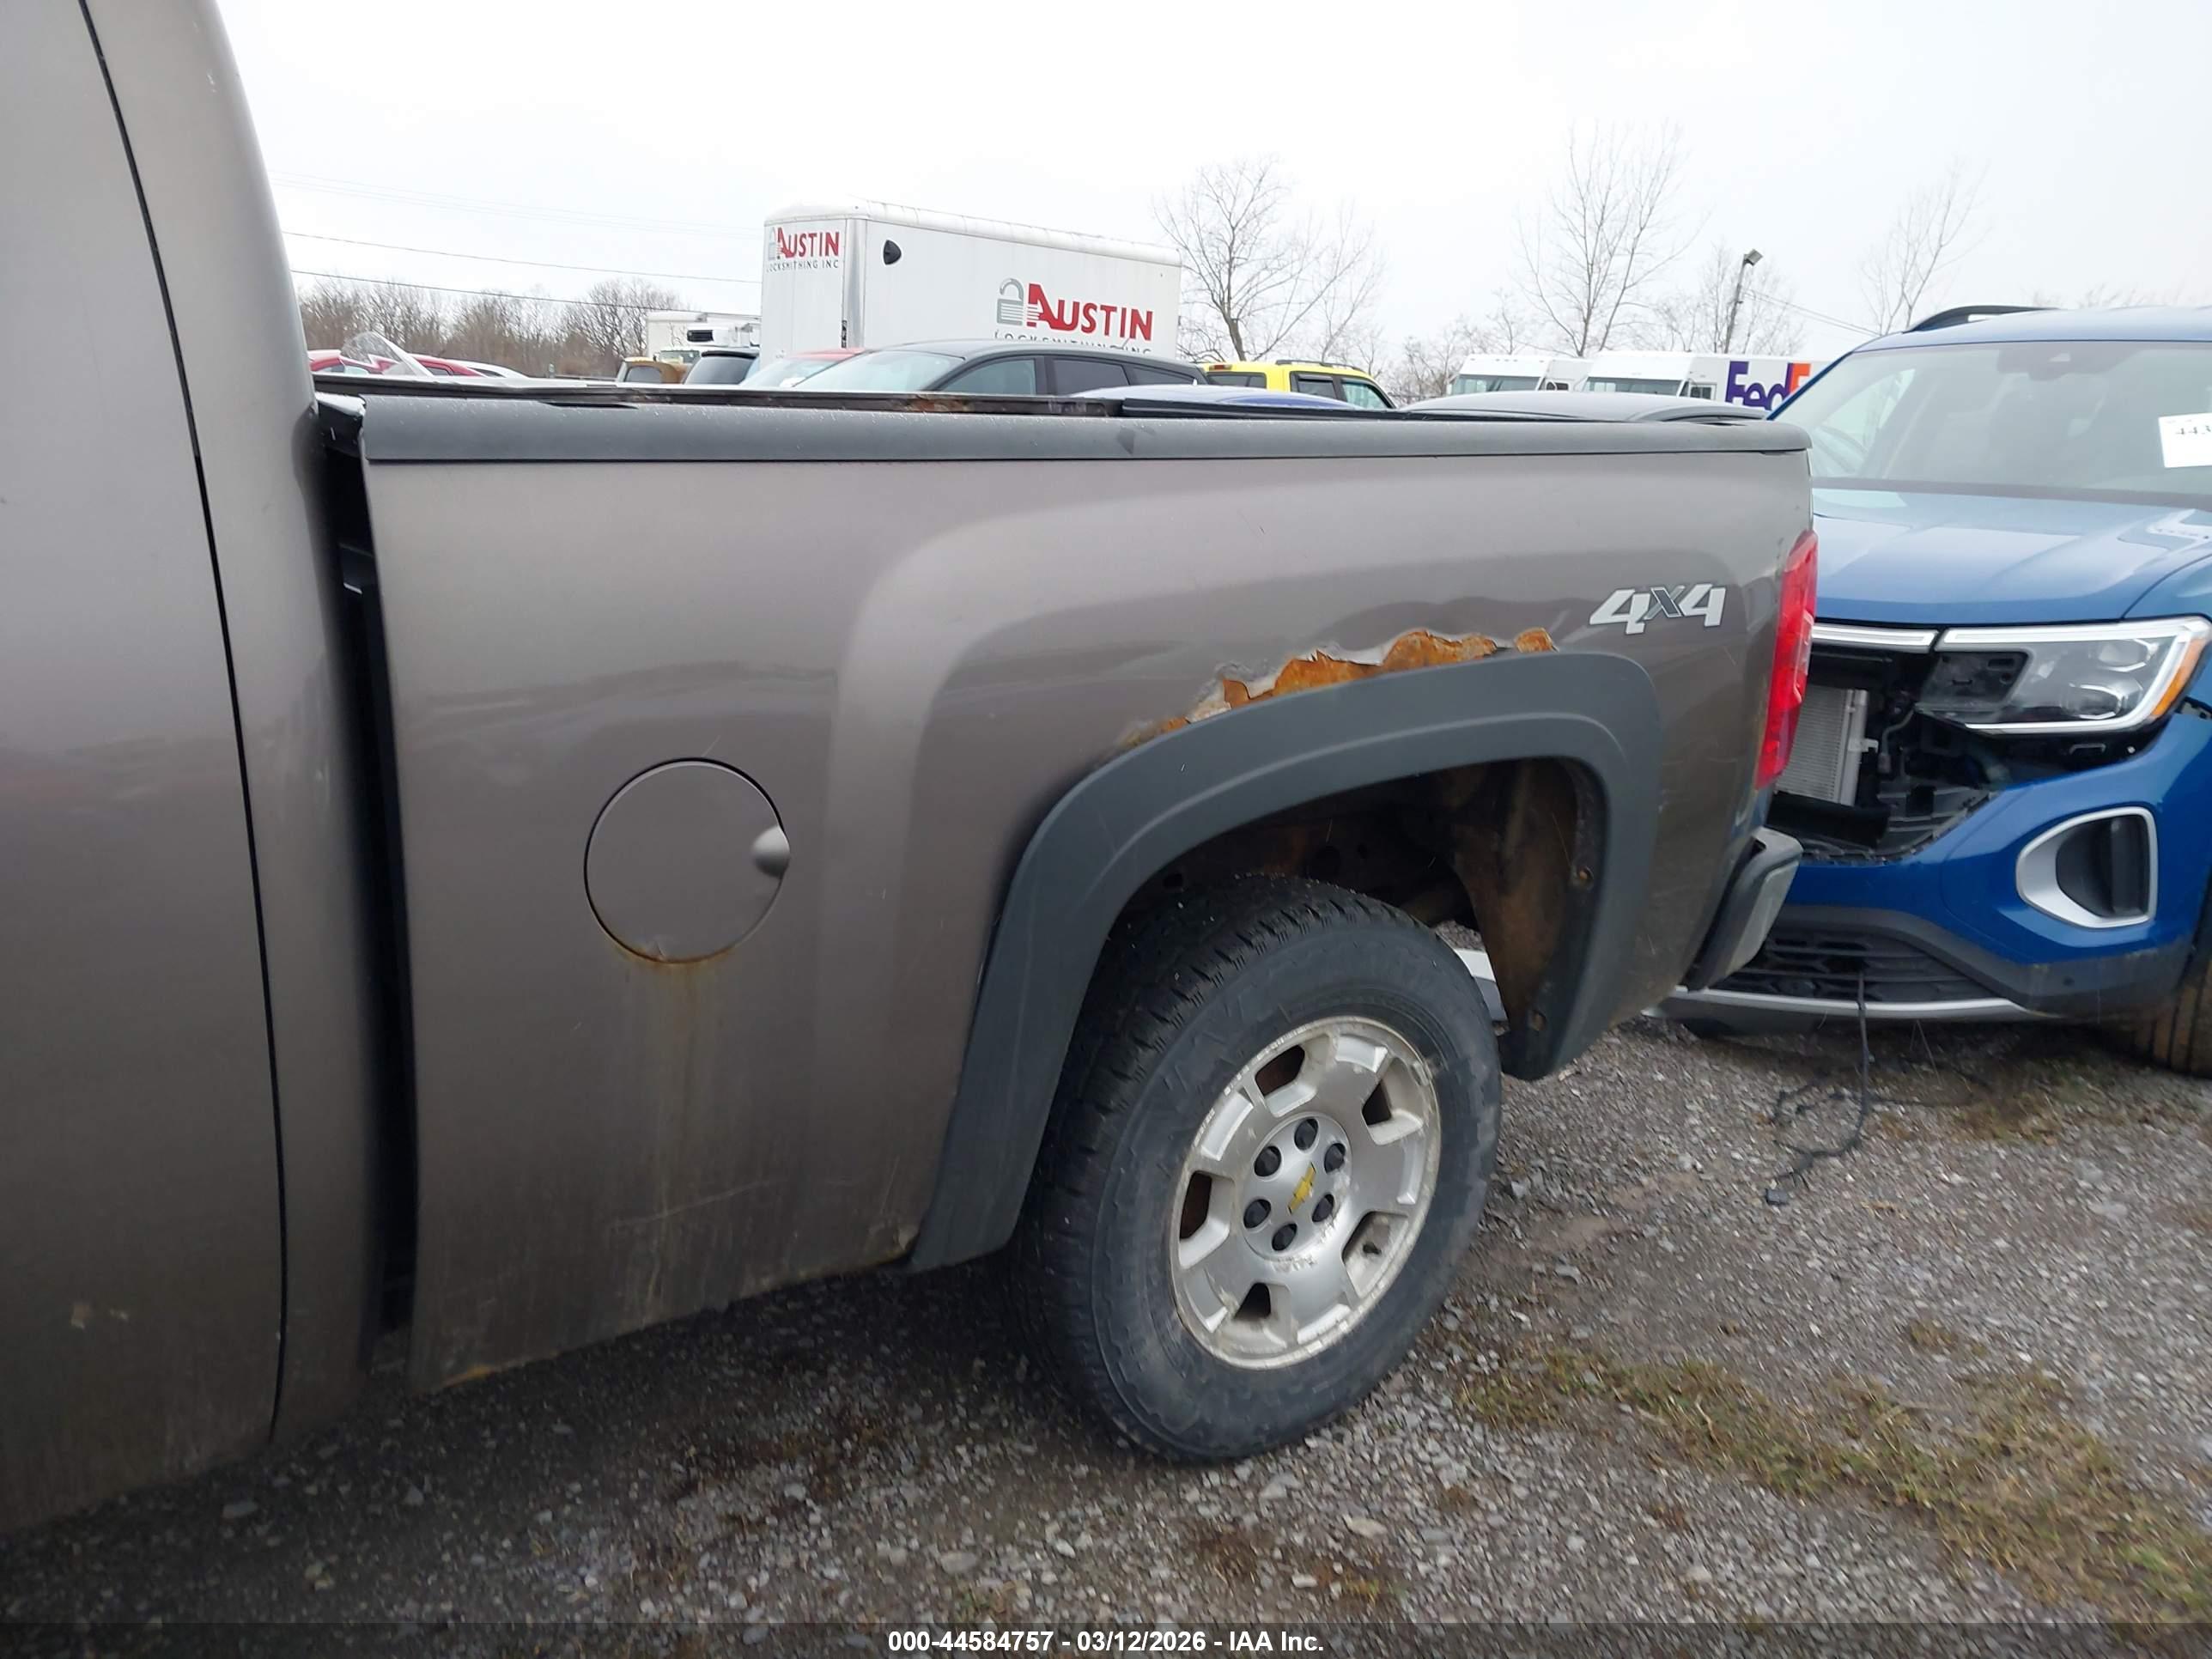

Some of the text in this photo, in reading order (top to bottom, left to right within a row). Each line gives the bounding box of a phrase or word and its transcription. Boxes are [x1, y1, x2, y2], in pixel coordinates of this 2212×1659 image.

[776, 227, 840, 259] AUSTIN
[822, 259, 839, 269] INC
[1026, 283, 1153, 341] AUSTIN
